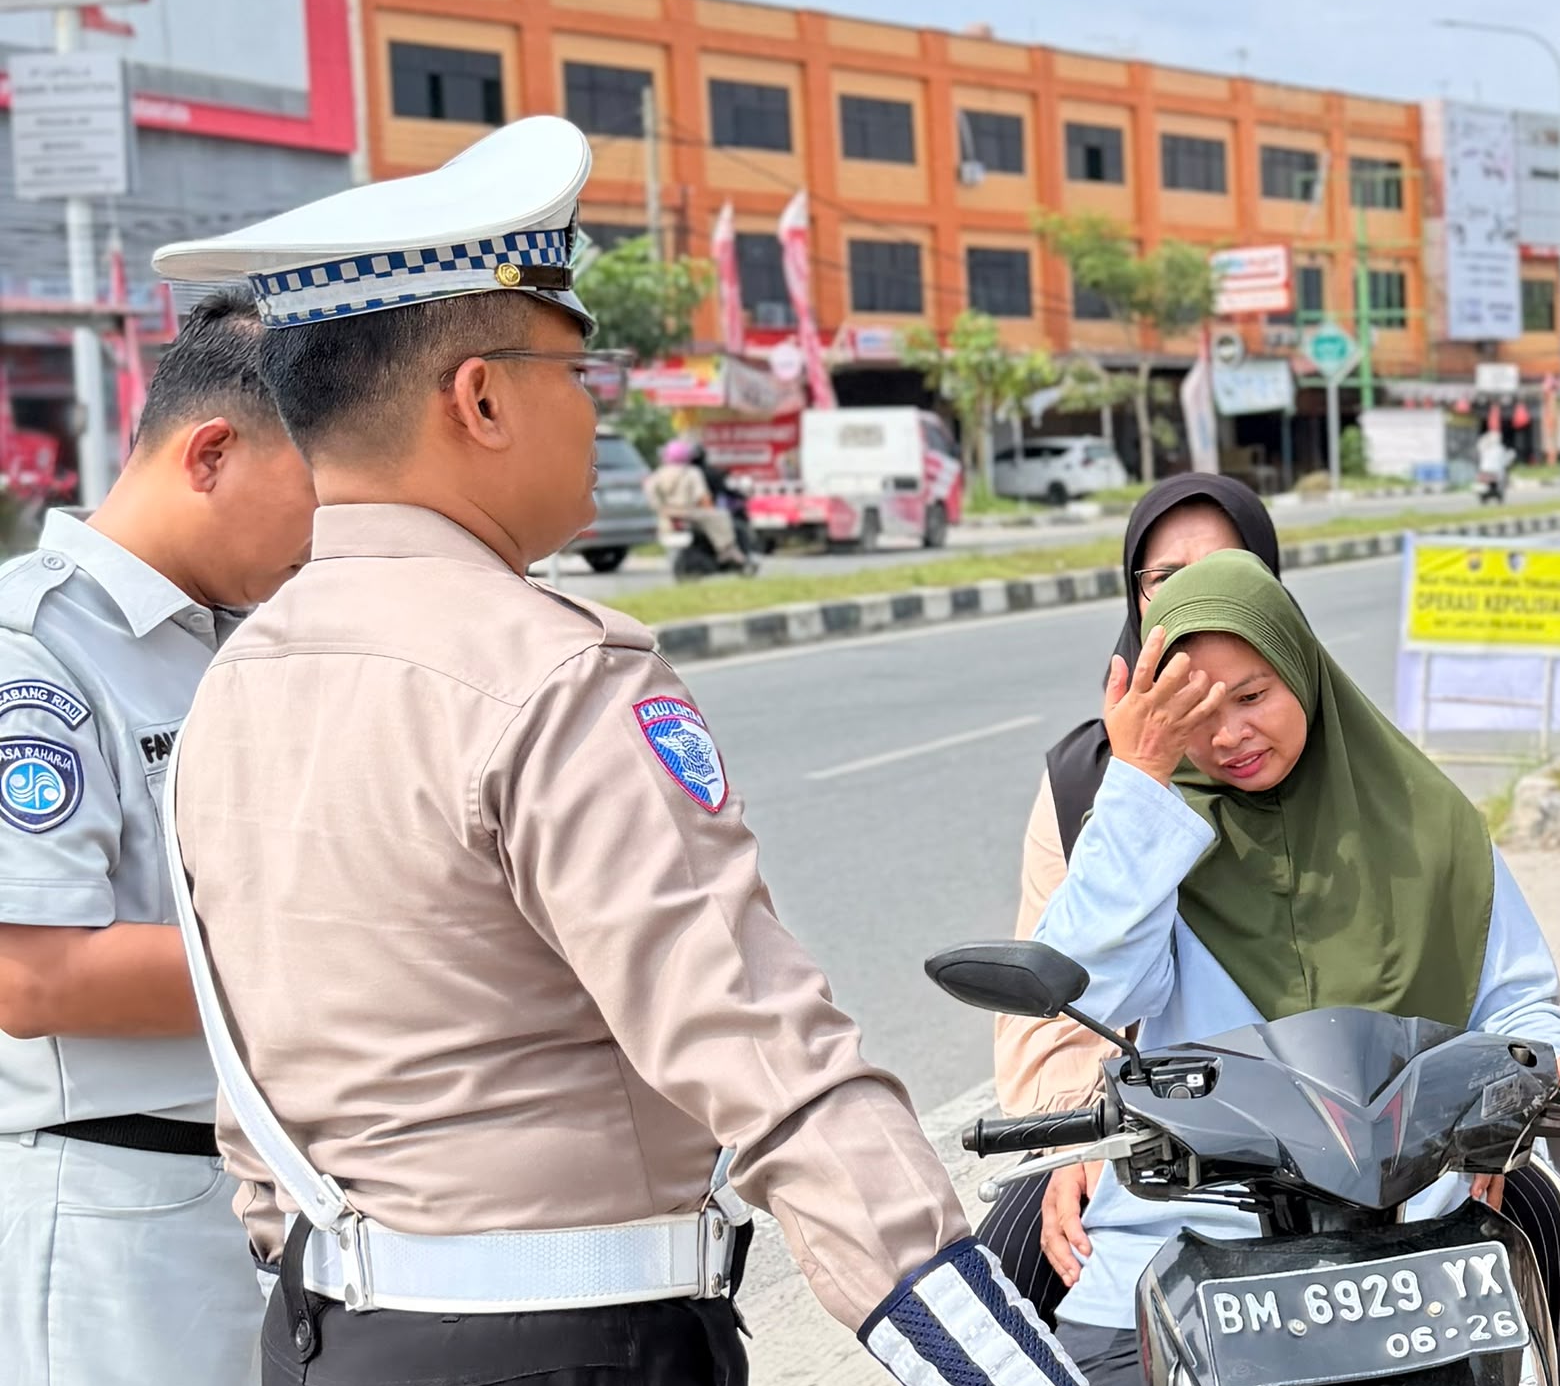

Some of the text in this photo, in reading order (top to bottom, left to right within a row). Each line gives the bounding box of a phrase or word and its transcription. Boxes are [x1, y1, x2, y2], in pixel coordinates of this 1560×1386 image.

[52, 694, 80, 718] RIAU
[0, 747, 72, 772] ASA RAHARJA
[1213, 1252, 1503, 1335] BM 6929 YX
